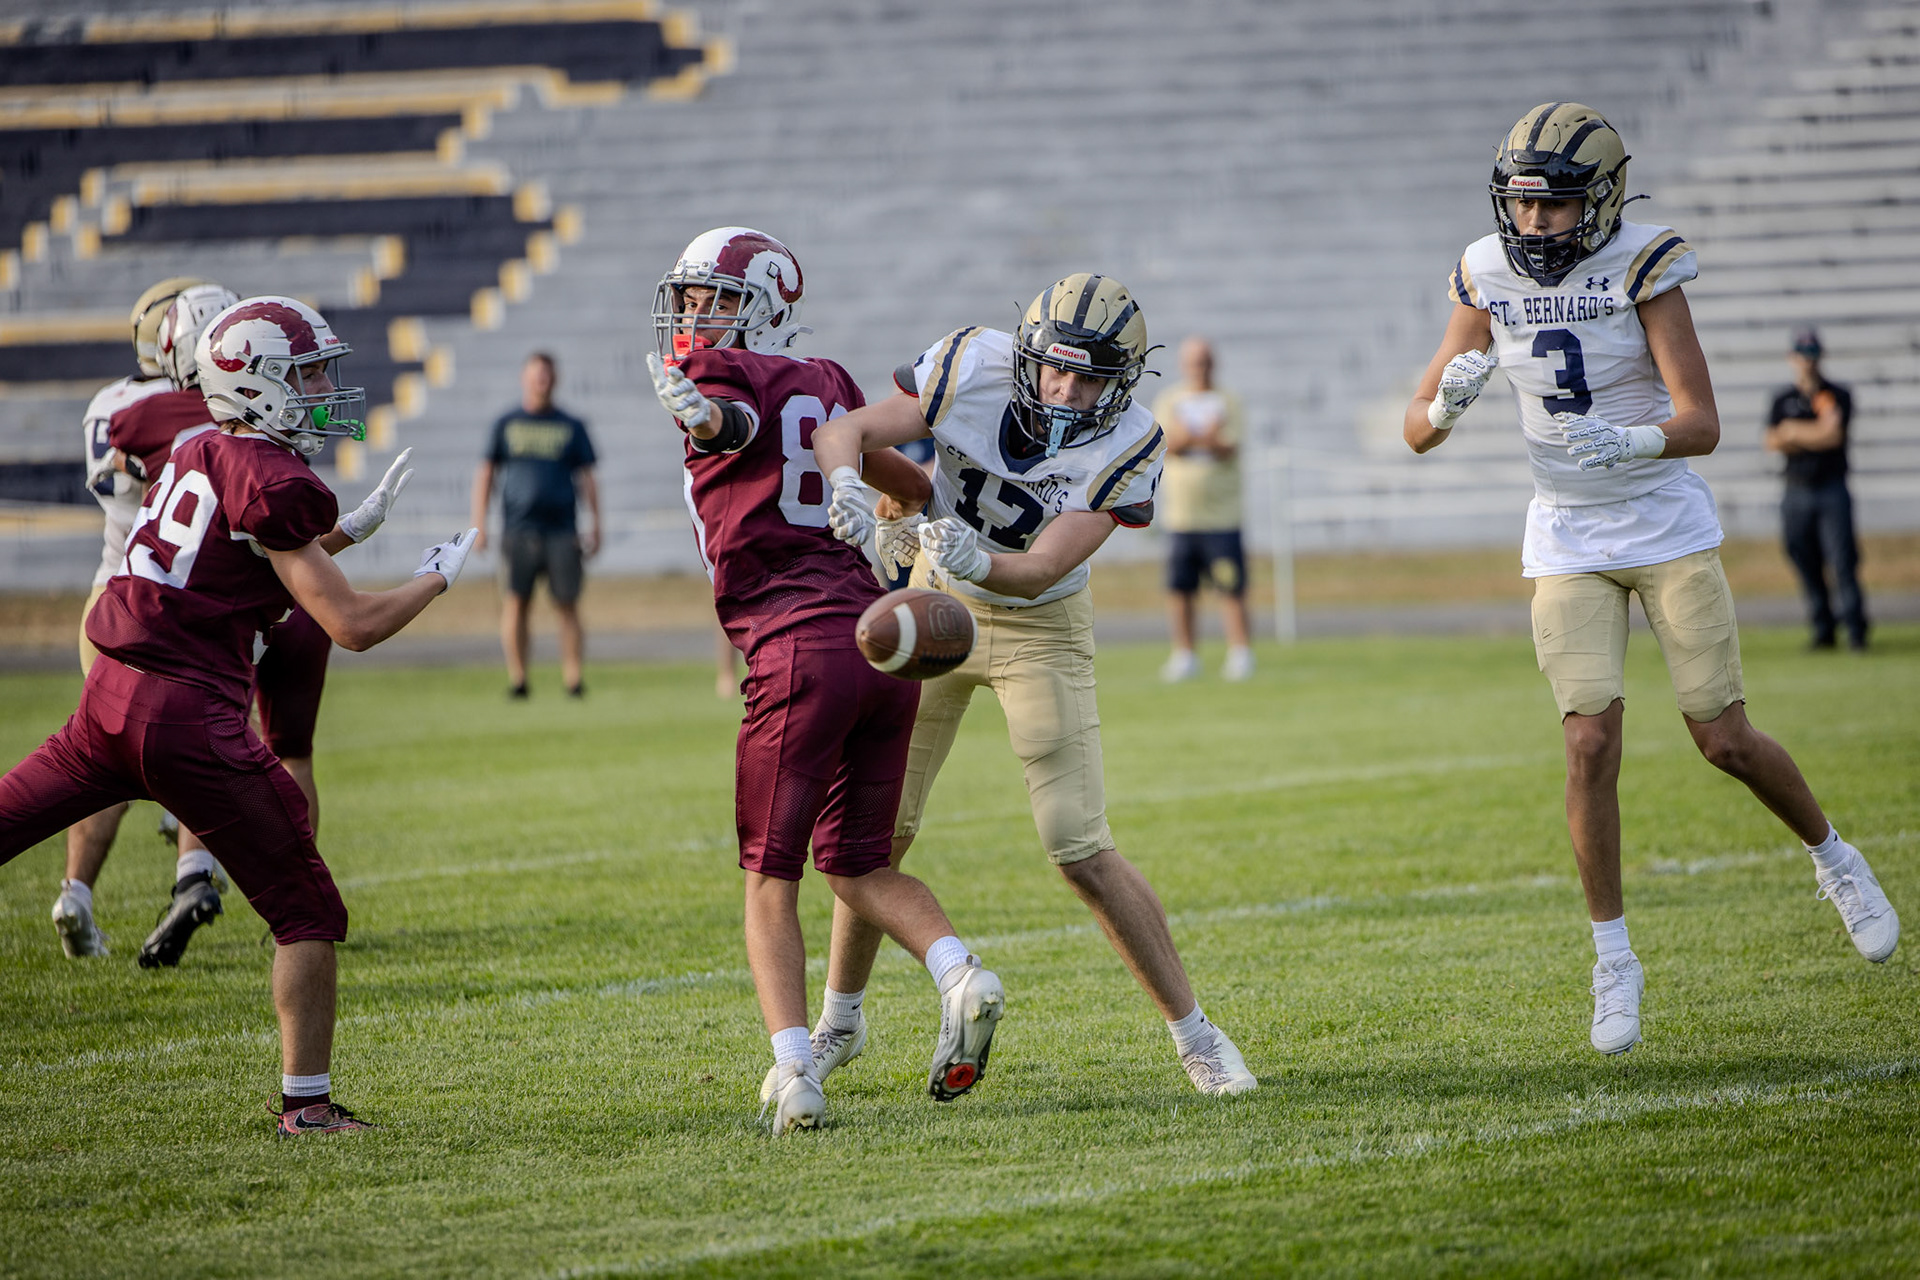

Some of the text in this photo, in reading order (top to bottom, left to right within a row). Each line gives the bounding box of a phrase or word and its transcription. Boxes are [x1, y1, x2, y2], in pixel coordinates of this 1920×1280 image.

[1511, 179, 1543, 188] Riddell
[1489, 296, 1614, 326] ST. BERNARD'S
[1052, 345, 1086, 361] Riddell
[1532, 328, 1593, 420] 3
[778, 395, 859, 528] 8
